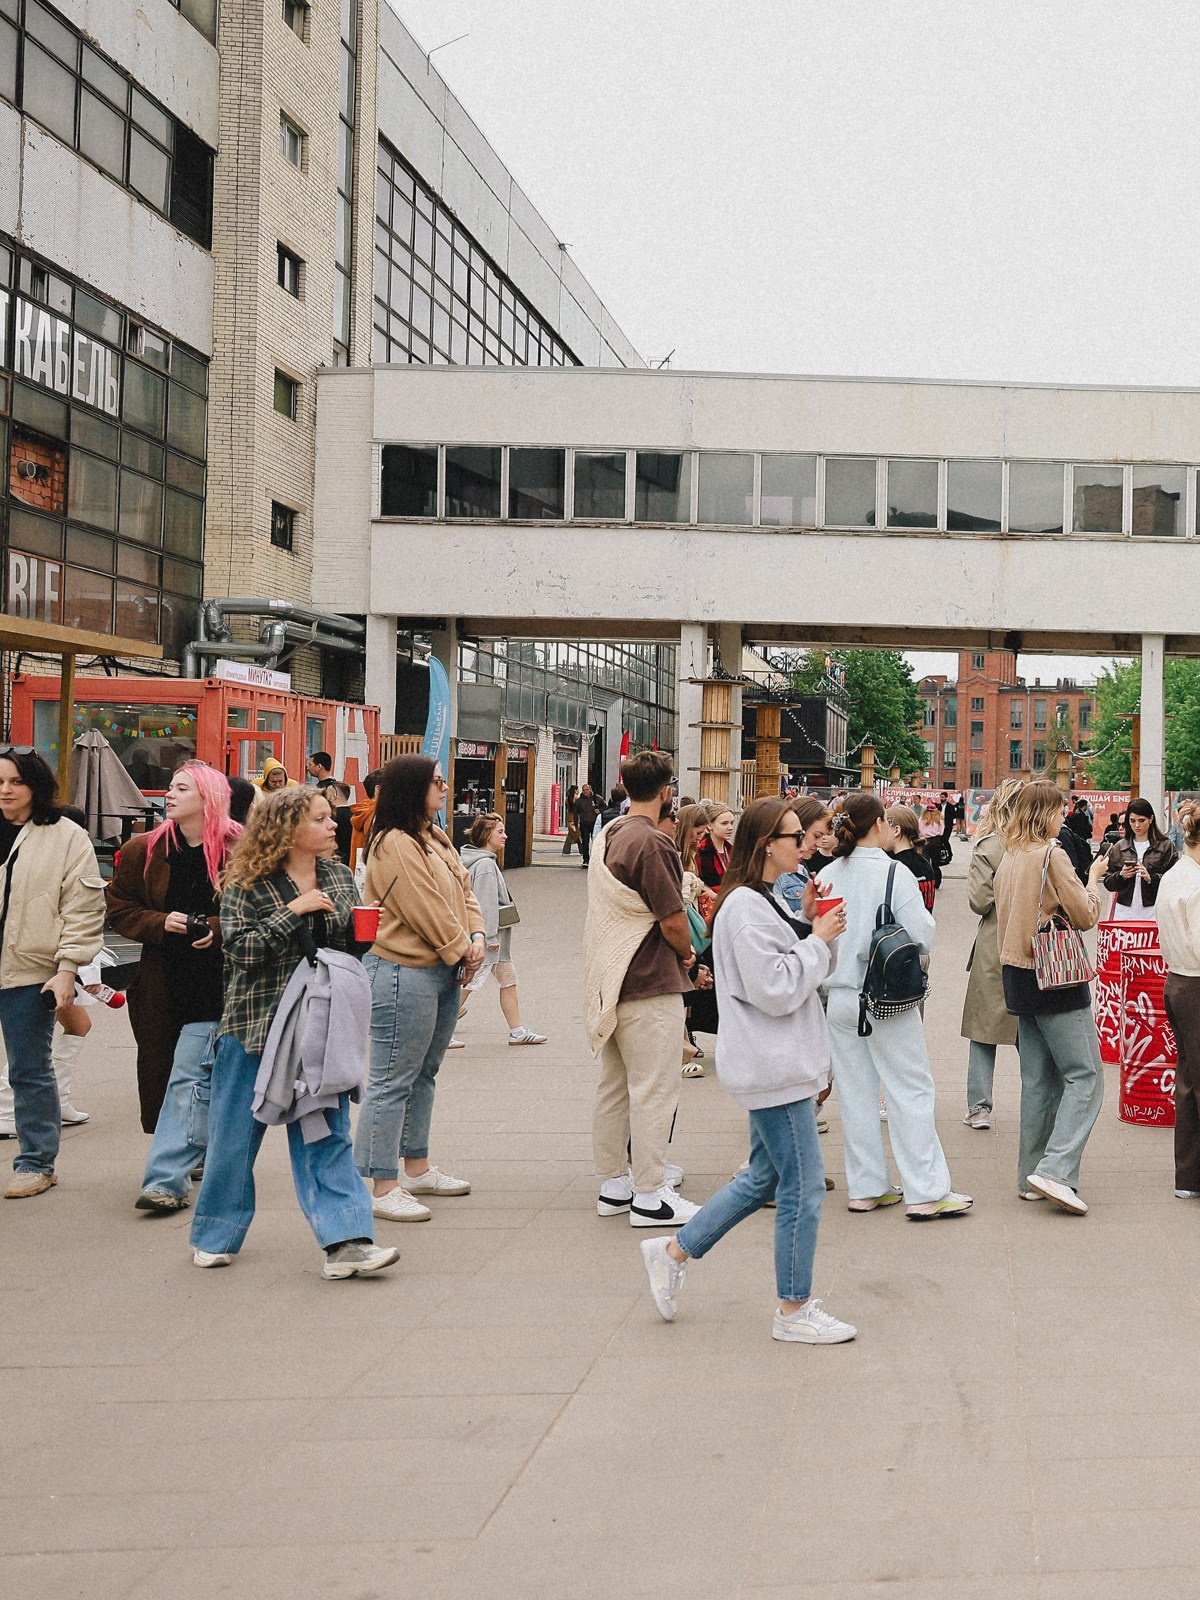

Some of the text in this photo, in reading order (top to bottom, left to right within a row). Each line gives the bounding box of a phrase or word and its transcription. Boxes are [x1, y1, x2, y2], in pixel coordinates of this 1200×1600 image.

[14, 297, 119, 417] КАБЕЛЬ
[1075, 794, 1131, 803] ЛУШАЙ ENE
